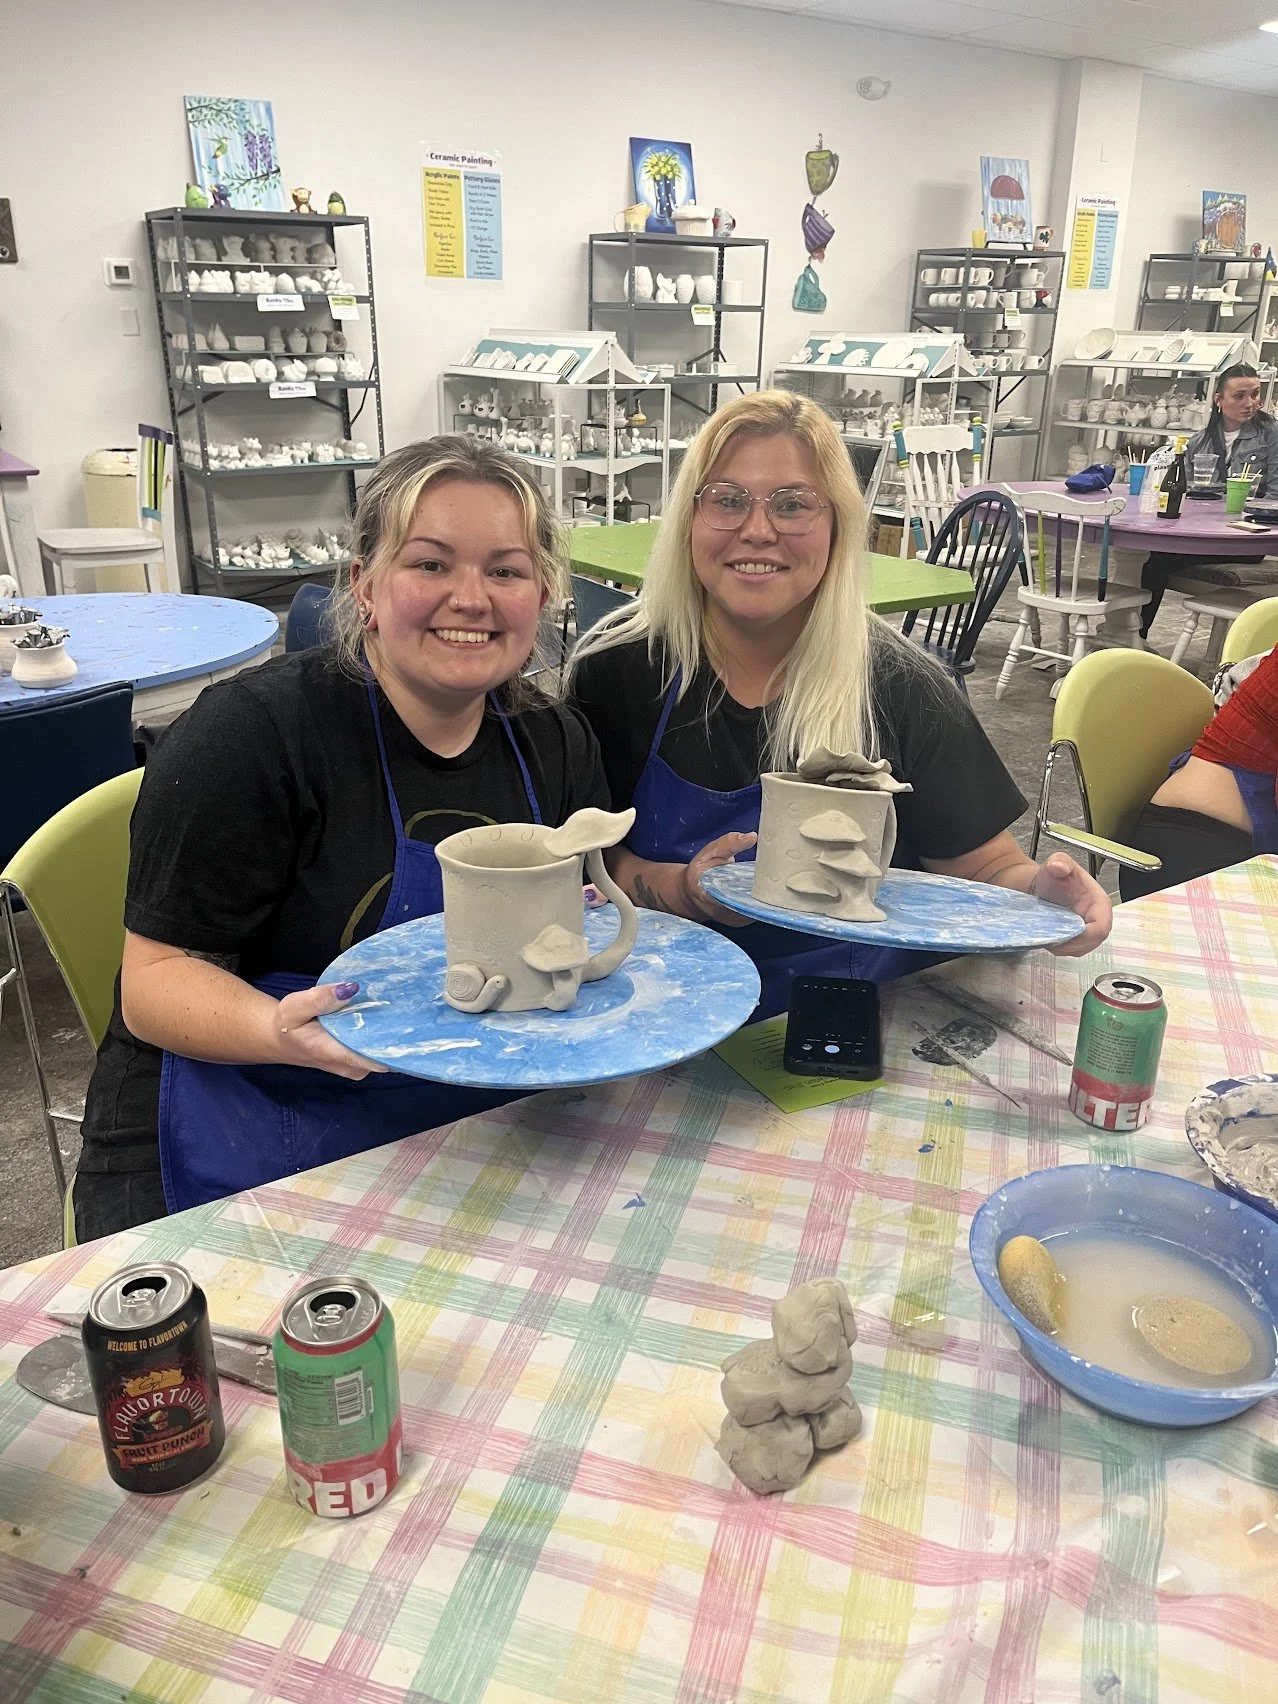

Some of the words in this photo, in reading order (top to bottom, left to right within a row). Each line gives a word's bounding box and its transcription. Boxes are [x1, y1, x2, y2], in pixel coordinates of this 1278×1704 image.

[430, 152, 460, 163] Ceramic
[461, 155, 493, 168] Painting
[1081, 197, 1097, 205] Ceramic
[1097, 198, 1116, 206] Painting
[107, 1340, 138, 1352] WELCOME
[139, 1339, 148, 1350] TO
[148, 1320, 189, 1348] FLAVORTOWN
[113, 1386, 207, 1441] FLAVORTOWN
[122, 1444, 158, 1458] FRUIT
[161, 1425, 205, 1451] PUNCH
